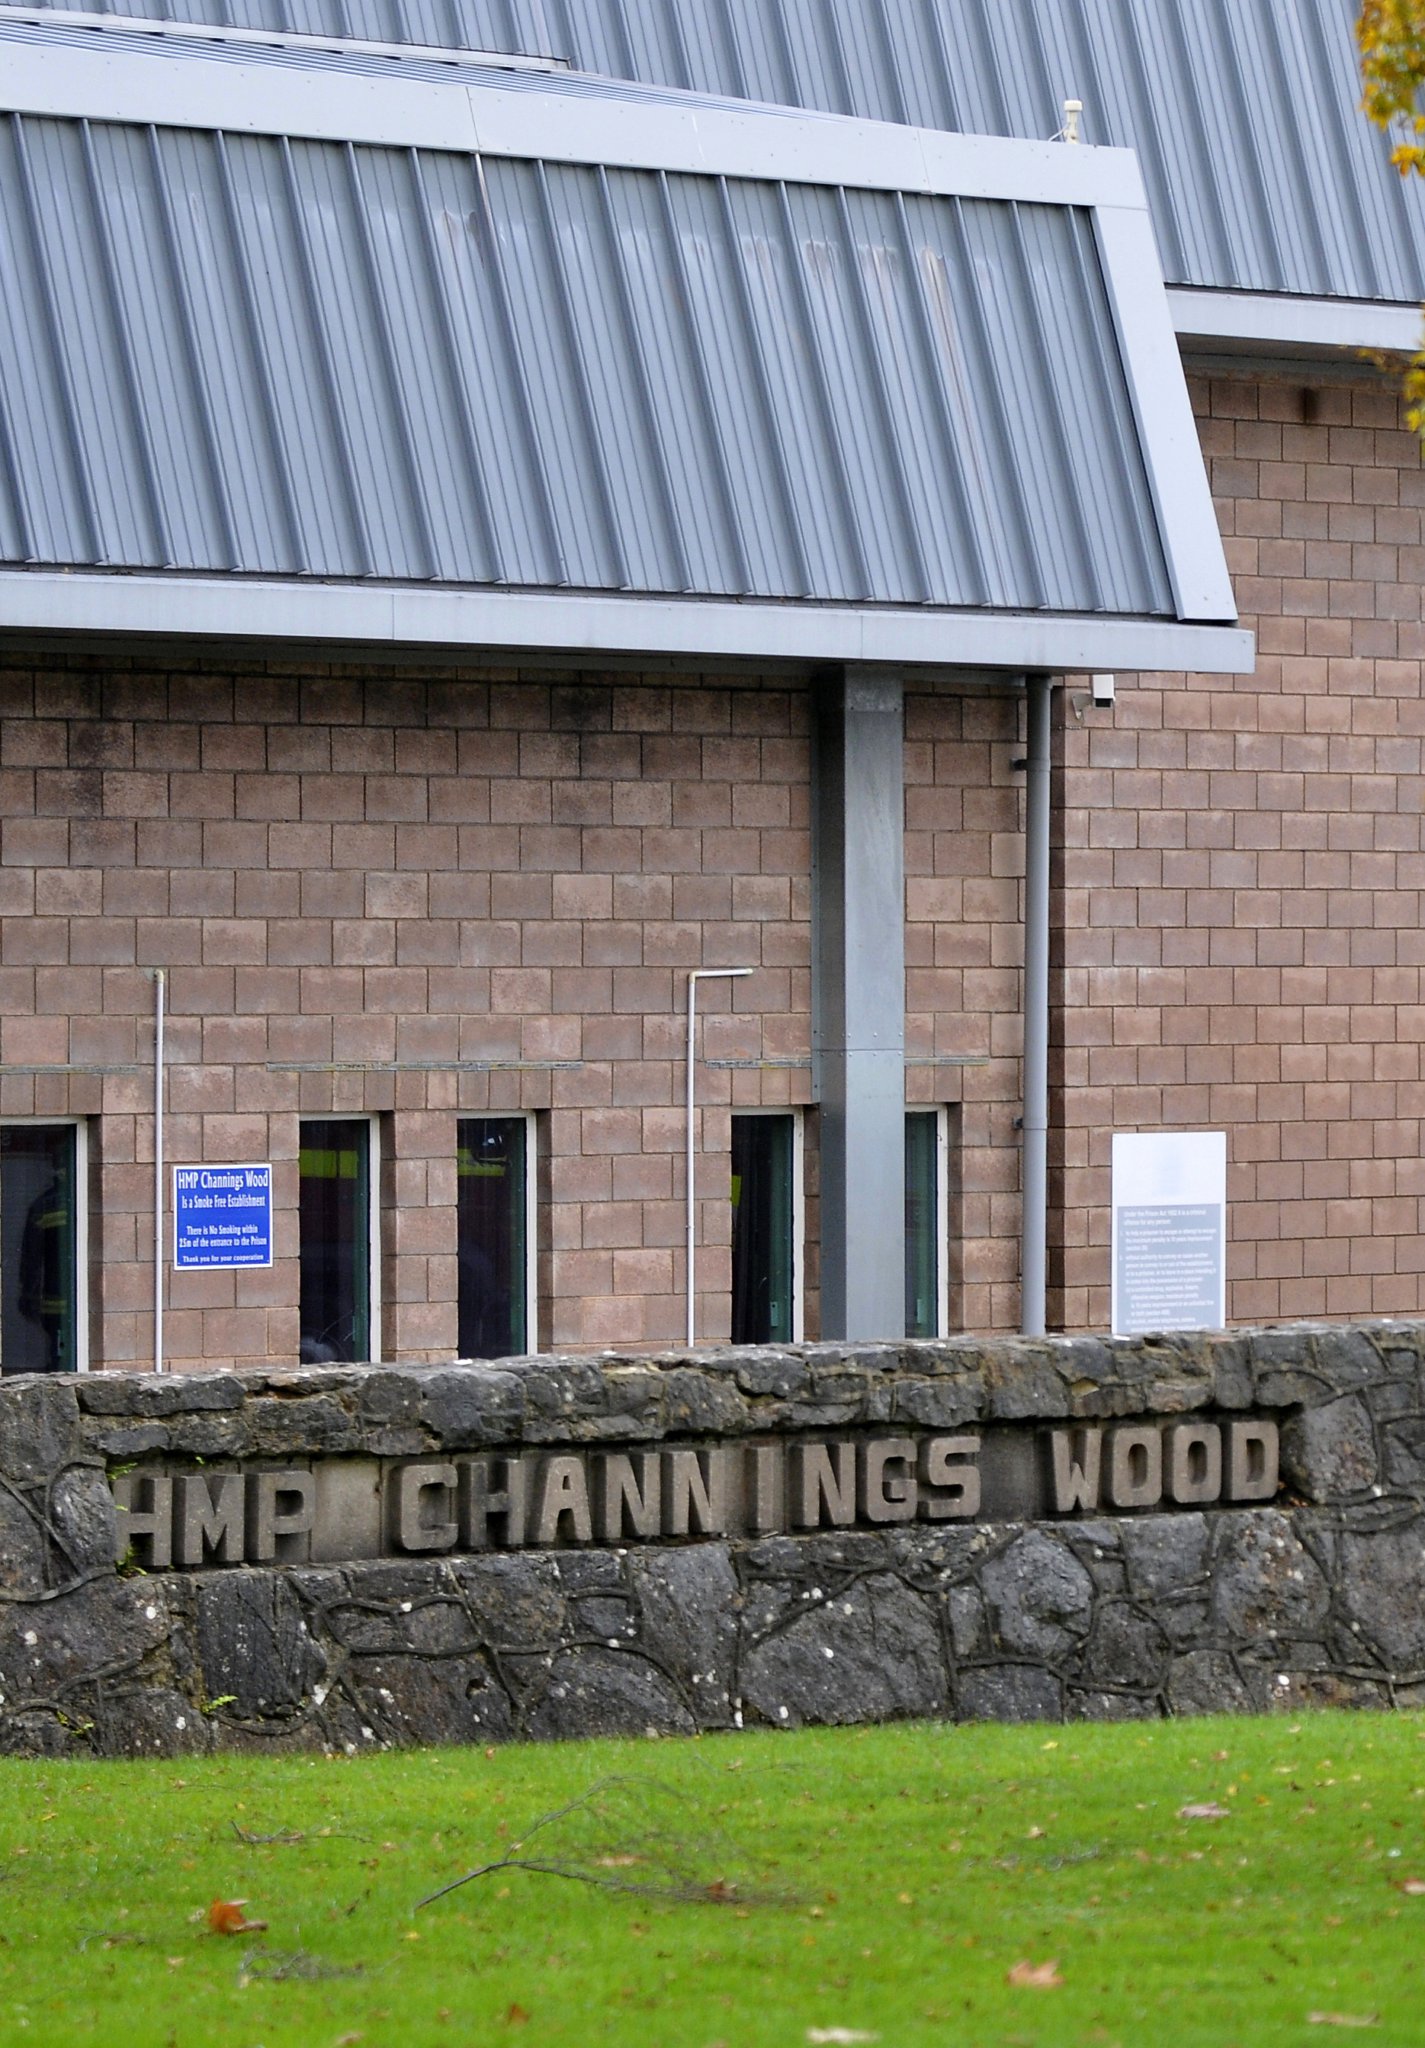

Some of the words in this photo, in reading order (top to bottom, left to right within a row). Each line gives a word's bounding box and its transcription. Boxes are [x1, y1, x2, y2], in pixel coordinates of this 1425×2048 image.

[178, 1172, 198, 1189] HMP
[201, 1171, 244, 1191] Channings
[245, 1170, 268, 1187] Wood
[182, 1196, 187, 1209] Is
[189, 1199, 193, 1208] a
[194, 1195, 213, 1208] Smoke
[214, 1195, 226, 1207] Free
[228, 1194, 265, 1207] Establishment
[186, 1225, 202, 1235] There
[203, 1225, 208, 1235] is
[209, 1225, 217, 1235] No
[219, 1225, 241, 1235] Smoking
[242, 1224, 258, 1233] within
[193, 1238, 199, 1247] of
[200, 1237, 208, 1247] the
[210, 1238, 232, 1246] entrance
[234, 1237, 240, 1246] to
[241, 1237, 250, 1246] the
[251, 1236, 267, 1245] Prison
[110, 1470, 316, 1567] HMP
[395, 1435, 981, 1552] CHANNINGS
[1050, 1420, 1280, 1513] WOOD
